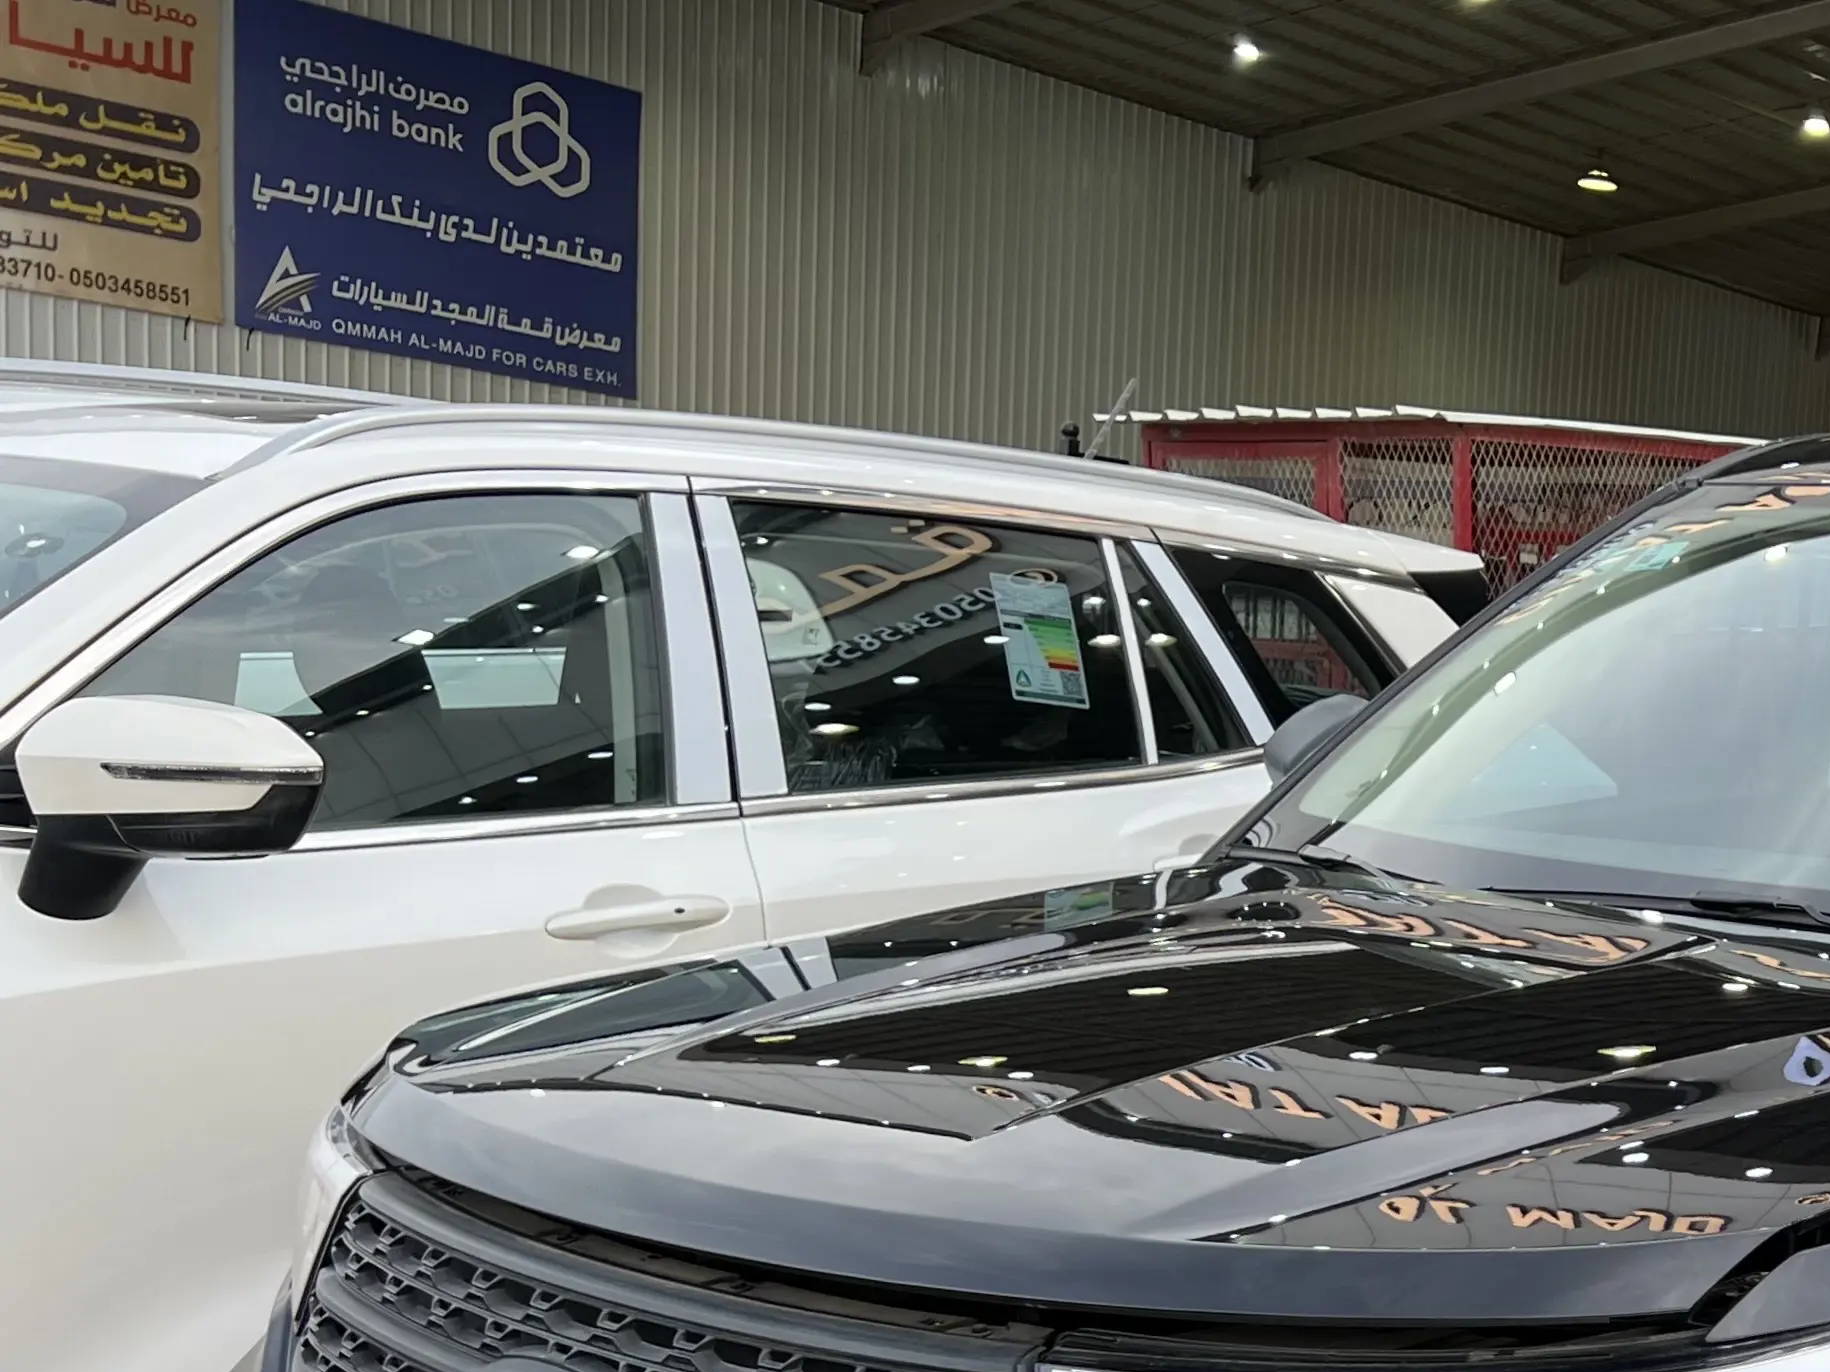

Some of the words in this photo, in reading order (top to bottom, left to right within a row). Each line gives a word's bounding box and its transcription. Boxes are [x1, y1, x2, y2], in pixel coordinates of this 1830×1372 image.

[279, 55, 385, 97] الراجحي
[387, 75, 470, 115] مصرف
[78, 104, 186, 143] نقل
[284, 89, 380, 133] alrajhi
[391, 109, 464, 152] bank
[252, 172, 373, 217] الراجحي
[375, 194, 436, 238] بنك
[500, 221, 623, 273] معتمدين
[69, 267, 191, 306] 0503458551
[331, 275, 429, 313] للسيارات
[267, 312, 322, 332] AL-MAJD
[431, 297, 496, 327] المجد
[331, 318, 402, 345] QMMAH
[408, 332, 487, 361] AL-MAJD
[492, 349, 527, 370] FOR
[532, 357, 578, 379] CARS
[555, 321, 622, 353] معرض
